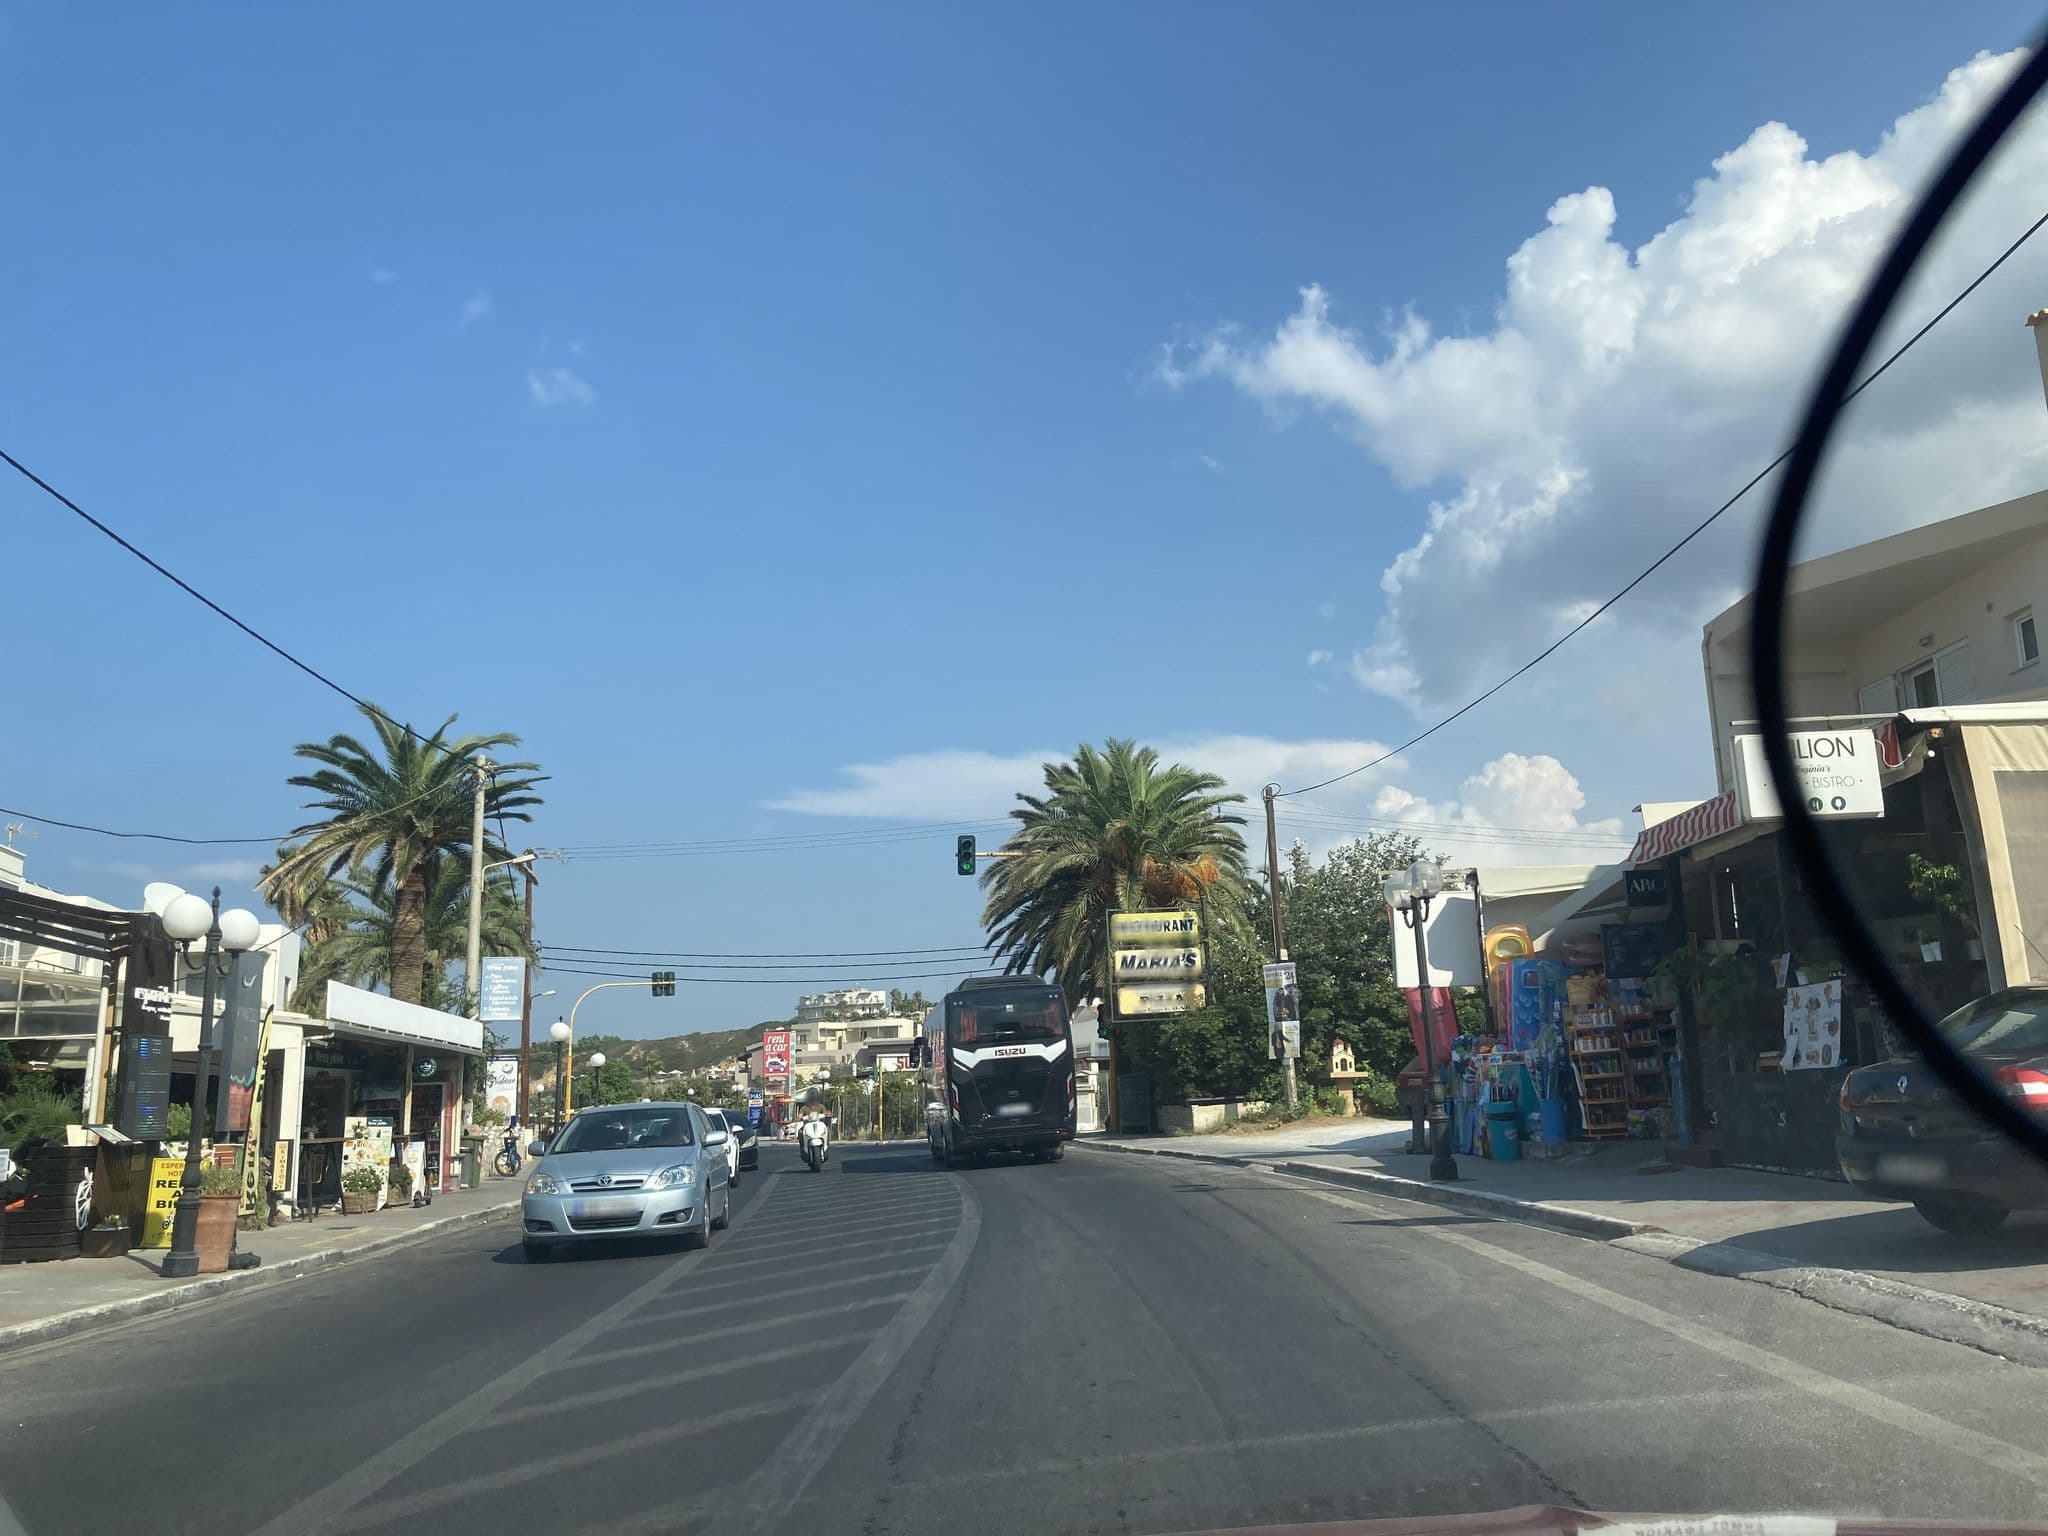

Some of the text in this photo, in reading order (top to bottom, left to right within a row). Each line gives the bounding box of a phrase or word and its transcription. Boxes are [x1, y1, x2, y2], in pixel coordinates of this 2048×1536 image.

[1812, 776, 1856, 789] BISTRO
[1120, 952, 1197, 970] MARIA'S
[767, 1034, 786, 1044] rent
[765, 1044, 788, 1052] a car
[994, 1048, 1026, 1057] ISUZU
